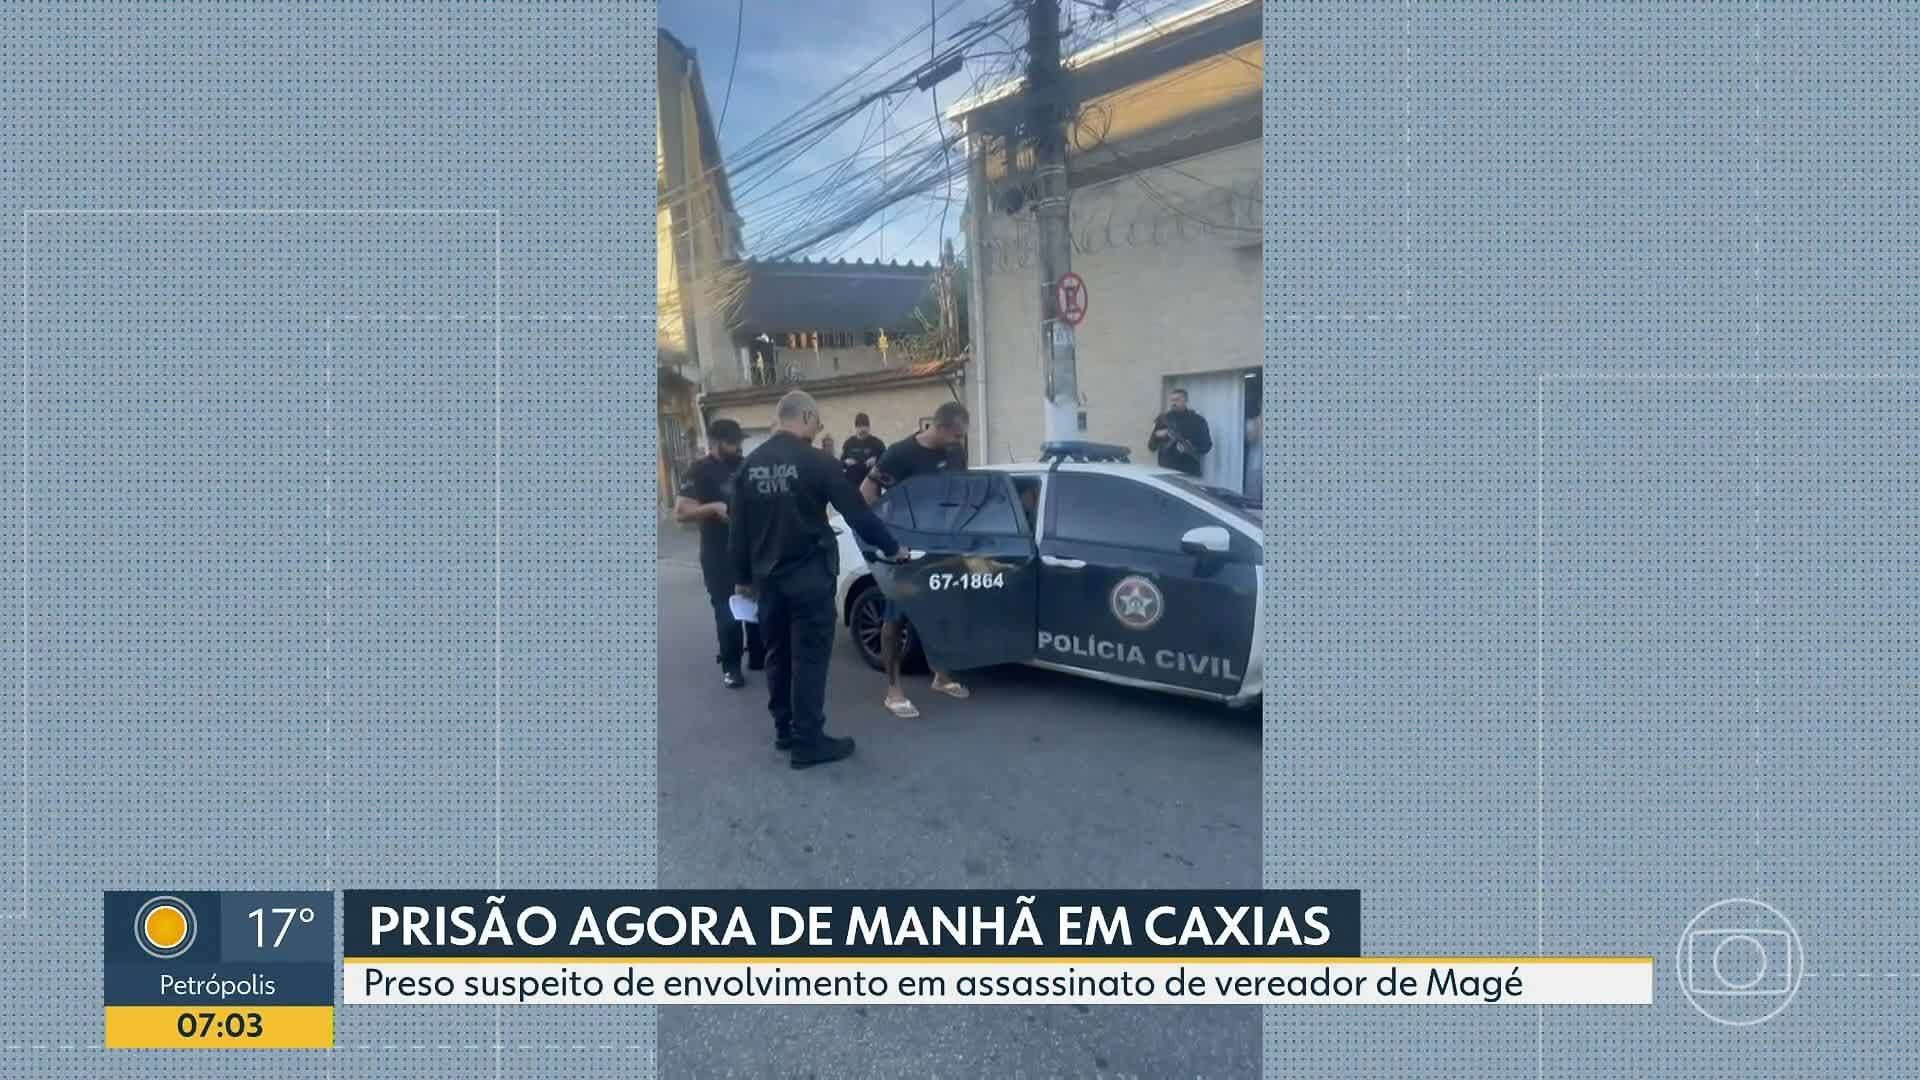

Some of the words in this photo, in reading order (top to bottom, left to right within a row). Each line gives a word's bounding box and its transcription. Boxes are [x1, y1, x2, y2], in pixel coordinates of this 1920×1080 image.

[929, 573, 1004, 591] 67-1864
[1038, 631, 1146, 665] POLÍCIA
[1155, 649, 1241, 681] CIVIL
